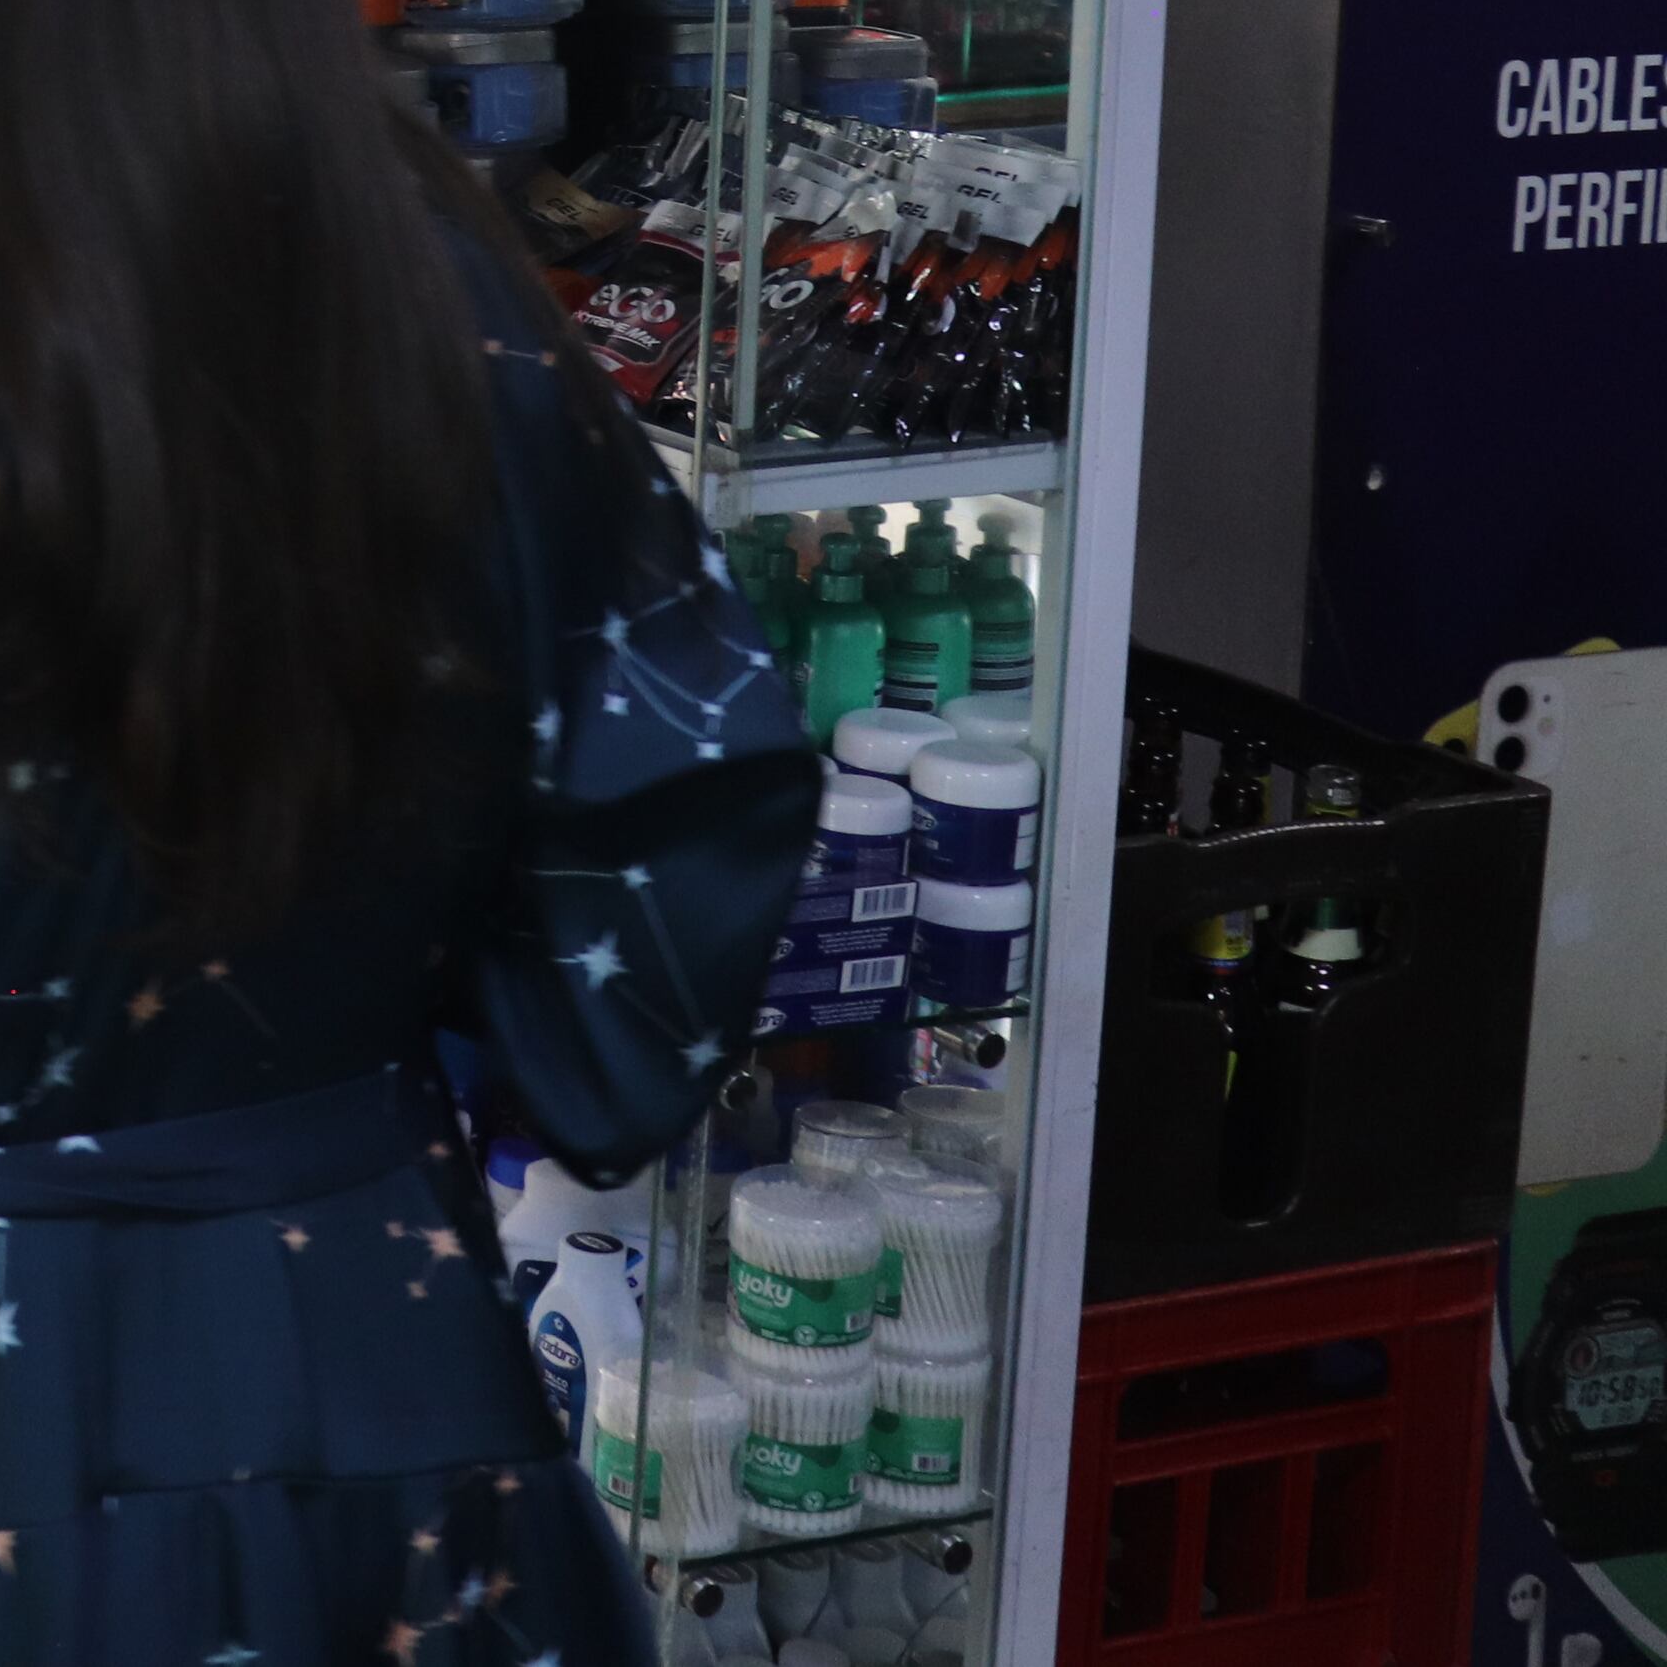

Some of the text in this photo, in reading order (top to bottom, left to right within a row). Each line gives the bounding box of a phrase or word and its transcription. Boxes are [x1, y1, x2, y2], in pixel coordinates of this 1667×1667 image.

[1496, 54, 1667, 139] CABLE
[546, 196, 583, 220] GEL
[897, 200, 930, 220] GEL
[1512, 168, 1667, 253] PERFI
[736, 1269, 793, 1310] yoky
